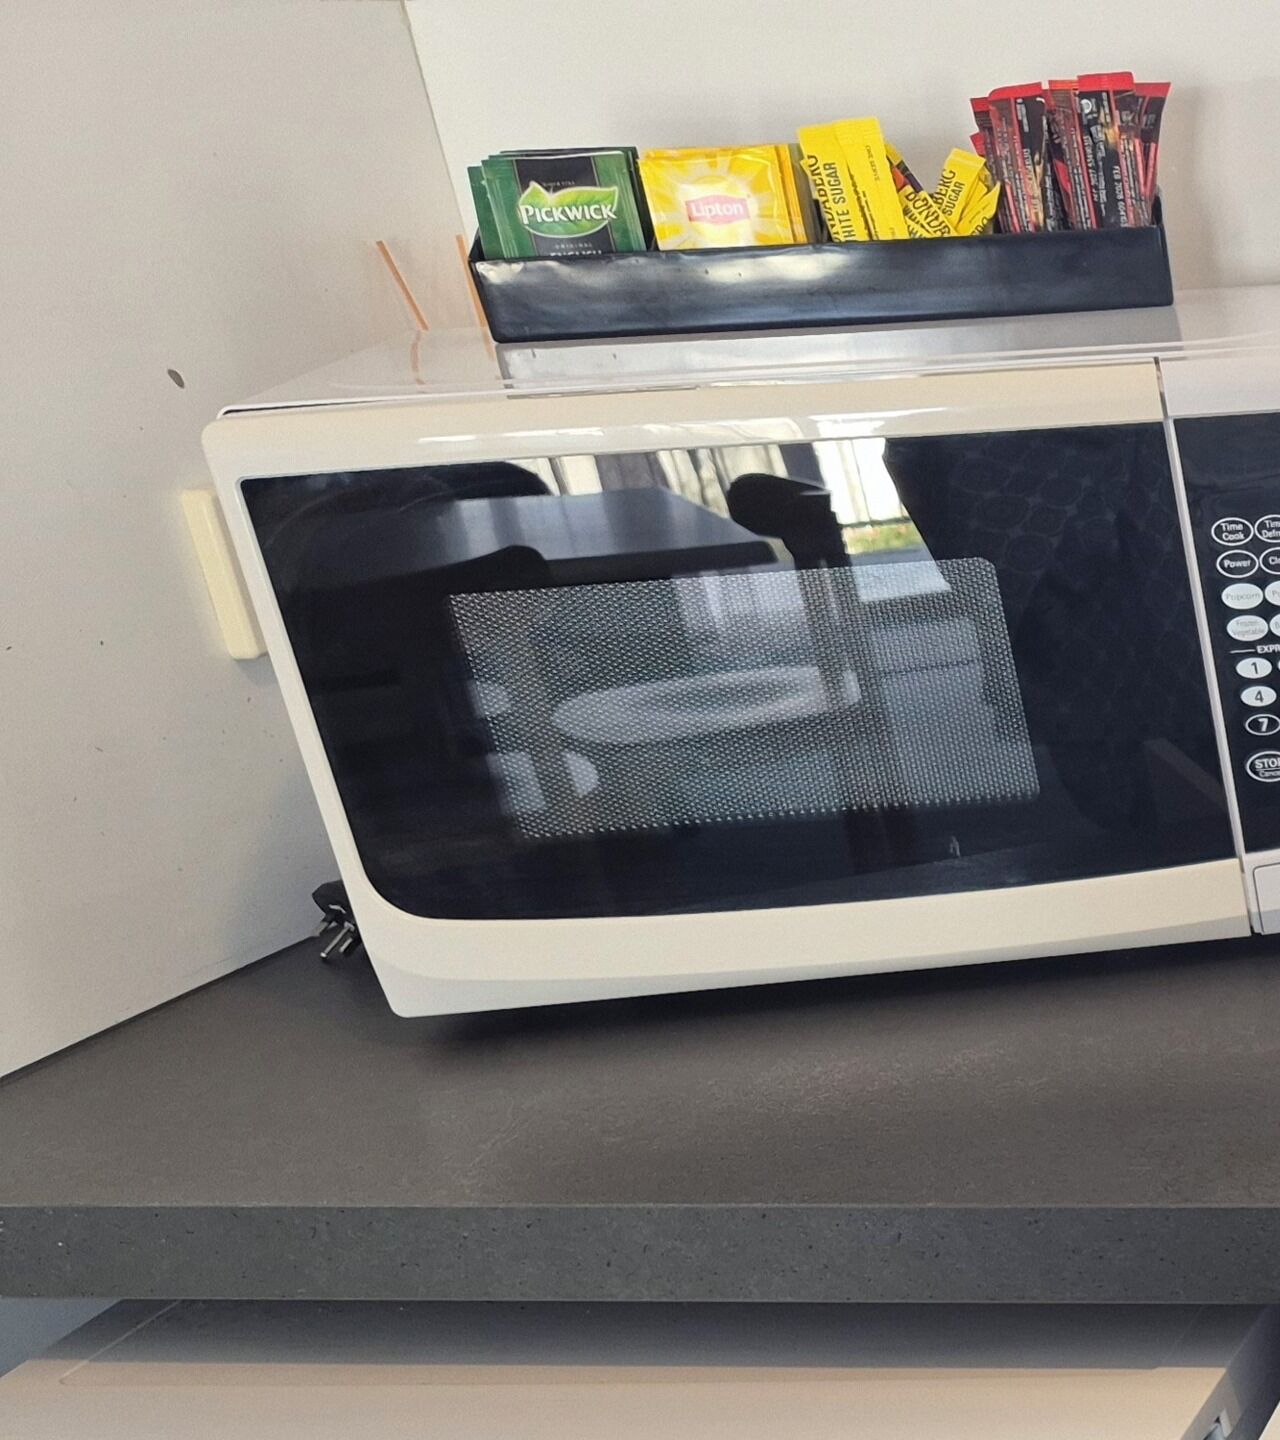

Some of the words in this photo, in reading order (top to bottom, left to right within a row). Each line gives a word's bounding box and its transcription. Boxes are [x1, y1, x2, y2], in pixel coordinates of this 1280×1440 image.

[823, 161, 846, 204] SUGAR
[942, 180, 966, 216] SUGAR
[520, 204, 617, 225] PICKWICK
[691, 202, 744, 219] Lipton
[836, 207, 858, 242] HITE
[1221, 523, 1243, 531] Time
[1222, 532, 1245, 541] Cook
[1223, 559, 1252, 568] Power
[1251, 662, 1258, 674] 1
[1254, 690, 1264, 703] 4
[1258, 718, 1268, 732] 7
